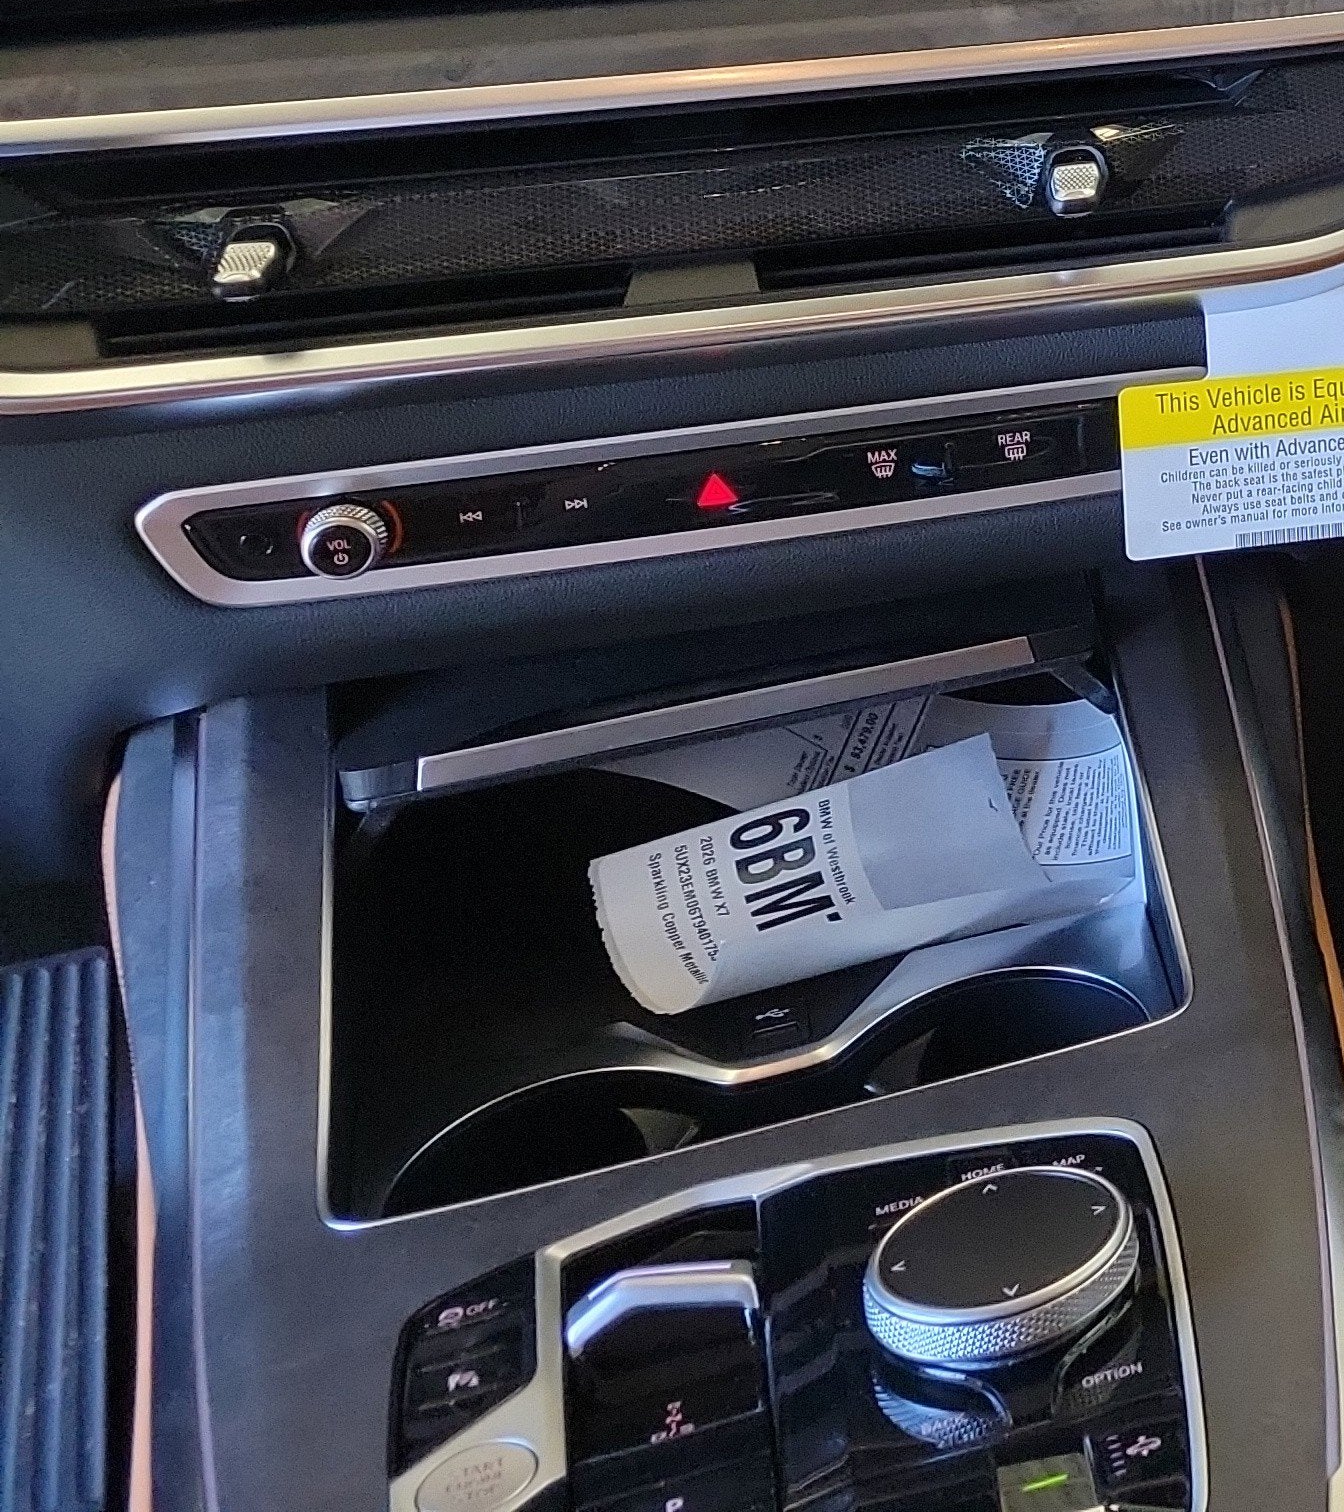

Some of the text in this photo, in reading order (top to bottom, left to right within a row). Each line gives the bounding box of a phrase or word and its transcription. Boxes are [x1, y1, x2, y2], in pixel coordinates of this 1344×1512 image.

[1155, 391, 1200, 414] This
[1206, 383, 1282, 409] Vehicle
[1288, 381, 1306, 402] is
[1211, 405, 1312, 436] Advanced
[997, 431, 1031, 447] REAR
[867, 448, 898, 464] MAX
[1189, 447, 1230, 467] Even
[1234, 441, 1270, 462] with
[1160, 469, 1206, 484] Children
[1209, 468, 1228, 479] can
[1231, 464, 1244, 476] be
[1247, 460, 1276, 474] killed
[1279, 460, 1291, 470] or
[1294, 454, 1342, 469] seriously
[1191, 480, 1212, 492] The
[1215, 476, 1241, 490] back
[1243, 474, 1265, 487] seat
[1268, 472, 1278, 484] is
[1281, 471, 1298, 483] the
[1301, 466, 1333, 481] safest
[1191, 491, 1222, 505] Never
[1226, 489, 1243, 502] put
[1246, 488, 1253, 498] a
[1256, 482, 1314, 498] rear-facing
[1317, 478, 1343, 491] child
[1201, 502, 1240, 516] Always
[1243, 499, 1262, 511] use
[1264, 496, 1287, 509] seat
[1290, 493, 1316, 506] belts
[1319, 490, 1338, 502] and
[1161, 520, 1182, 533] See
[1185, 514, 1227, 530] owner's
[1230, 509, 1269, 525] manual
[1272, 507, 1288, 520] for
[1291, 504, 1318, 517] more
[326, 538, 351, 551] VOL
[818, 798, 833, 830] BMW
[823, 833, 836, 845] of
[699, 836, 731, 917] 2026 BMW X7
[729, 808, 843, 932] 6BM
[826, 847, 856, 906] Westbrook
[647, 852, 669, 911] Sparkling
[661, 912, 686, 950] Copper
[960, 1163, 1006, 1182] HOME
[875, 1195, 925, 1216] MEDIA
[1081, 1361, 1143, 1389] OPTION
